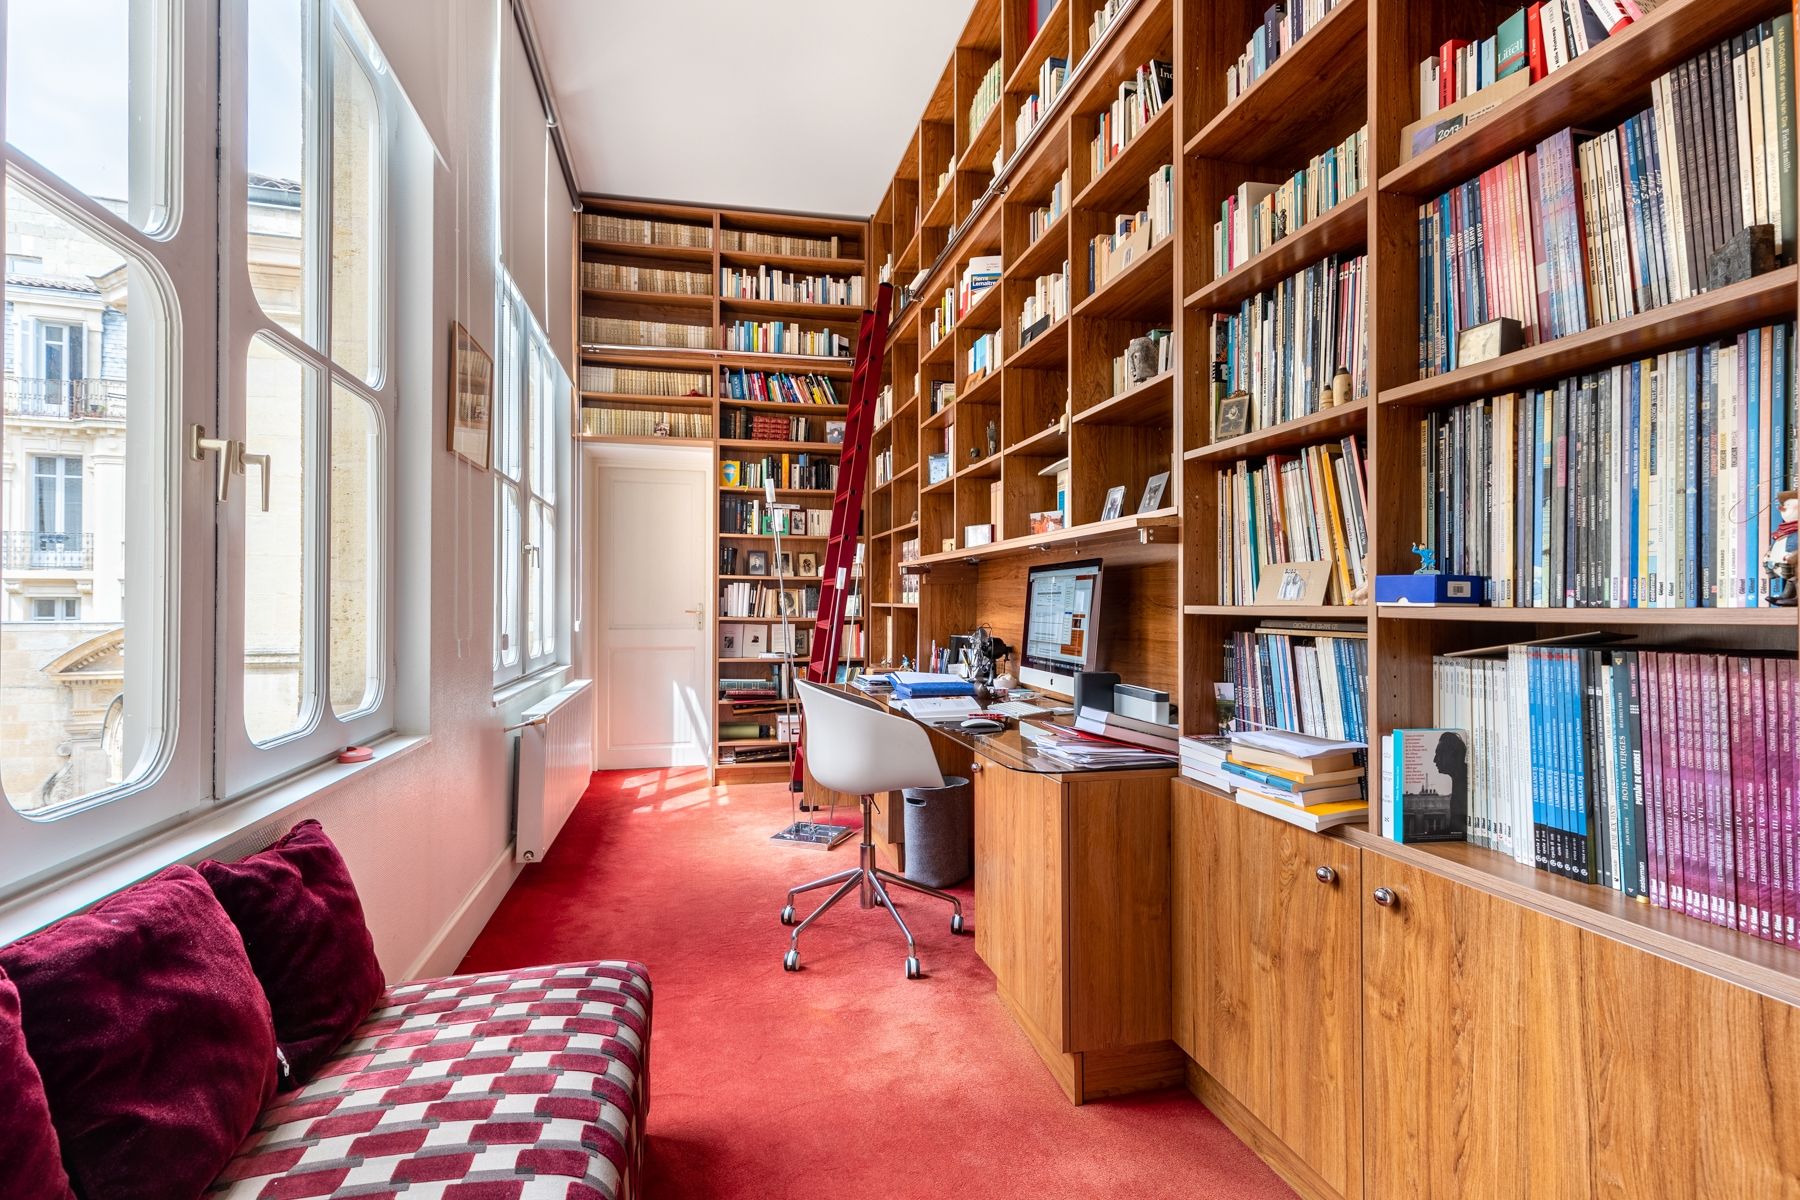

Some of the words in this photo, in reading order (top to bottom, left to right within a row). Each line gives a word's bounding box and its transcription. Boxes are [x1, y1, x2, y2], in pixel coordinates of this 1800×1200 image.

[1619, 735, 1627, 770] VIERGES
[1634, 775, 1641, 783] DE
[1621, 782, 1629, 801] BOIS
[1634, 784, 1643, 805] PUTAIN
